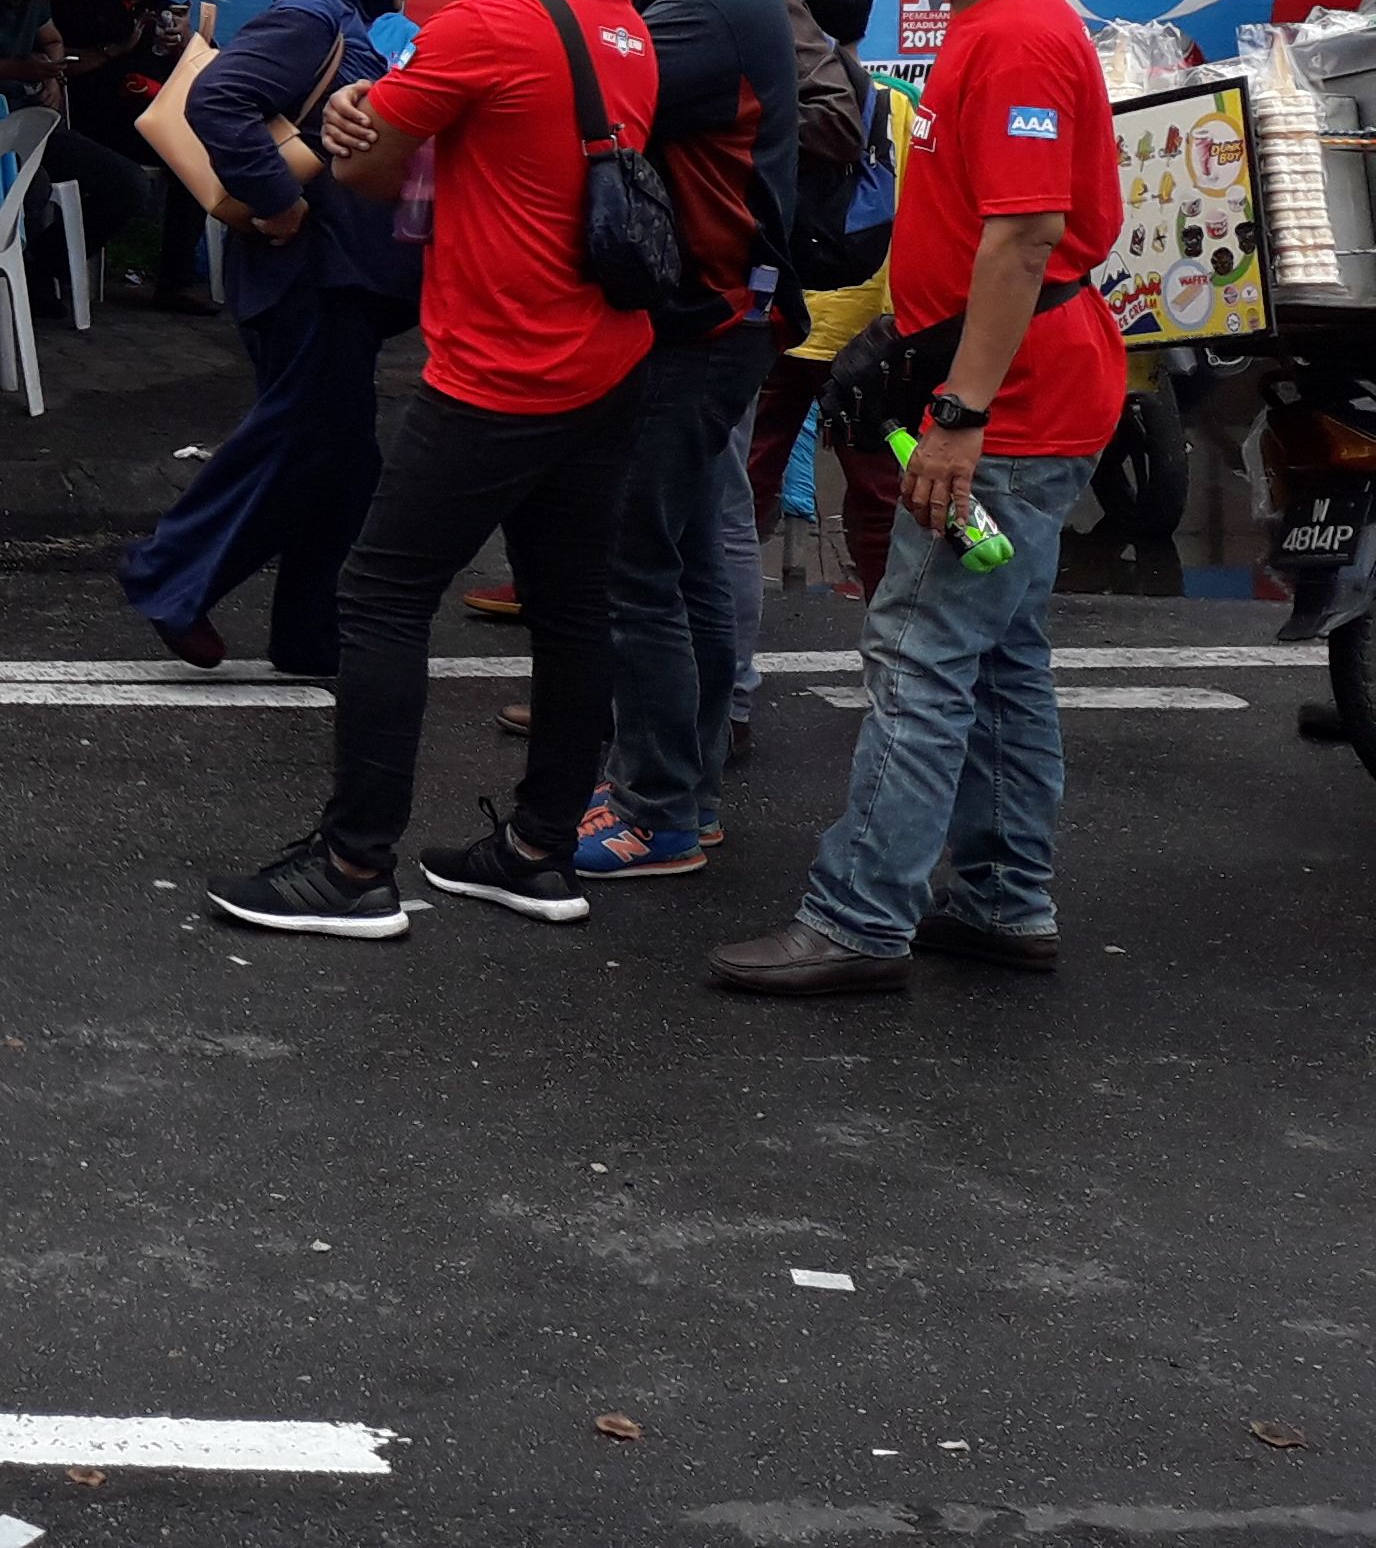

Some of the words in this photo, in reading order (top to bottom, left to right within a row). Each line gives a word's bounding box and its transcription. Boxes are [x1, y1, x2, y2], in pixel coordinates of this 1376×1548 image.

[903, 12, 950, 20] PEMILIHAN
[902, 30, 946, 48] 2018
[1011, 116, 1055, 132] AAA
[1218, 151, 1242, 165] BOY
[1179, 274, 1210, 286] WAFER
[1109, 271, 1162, 315] OLAR
[1128, 297, 1157, 320] CREAM
[1282, 525, 1353, 550] 4814P
